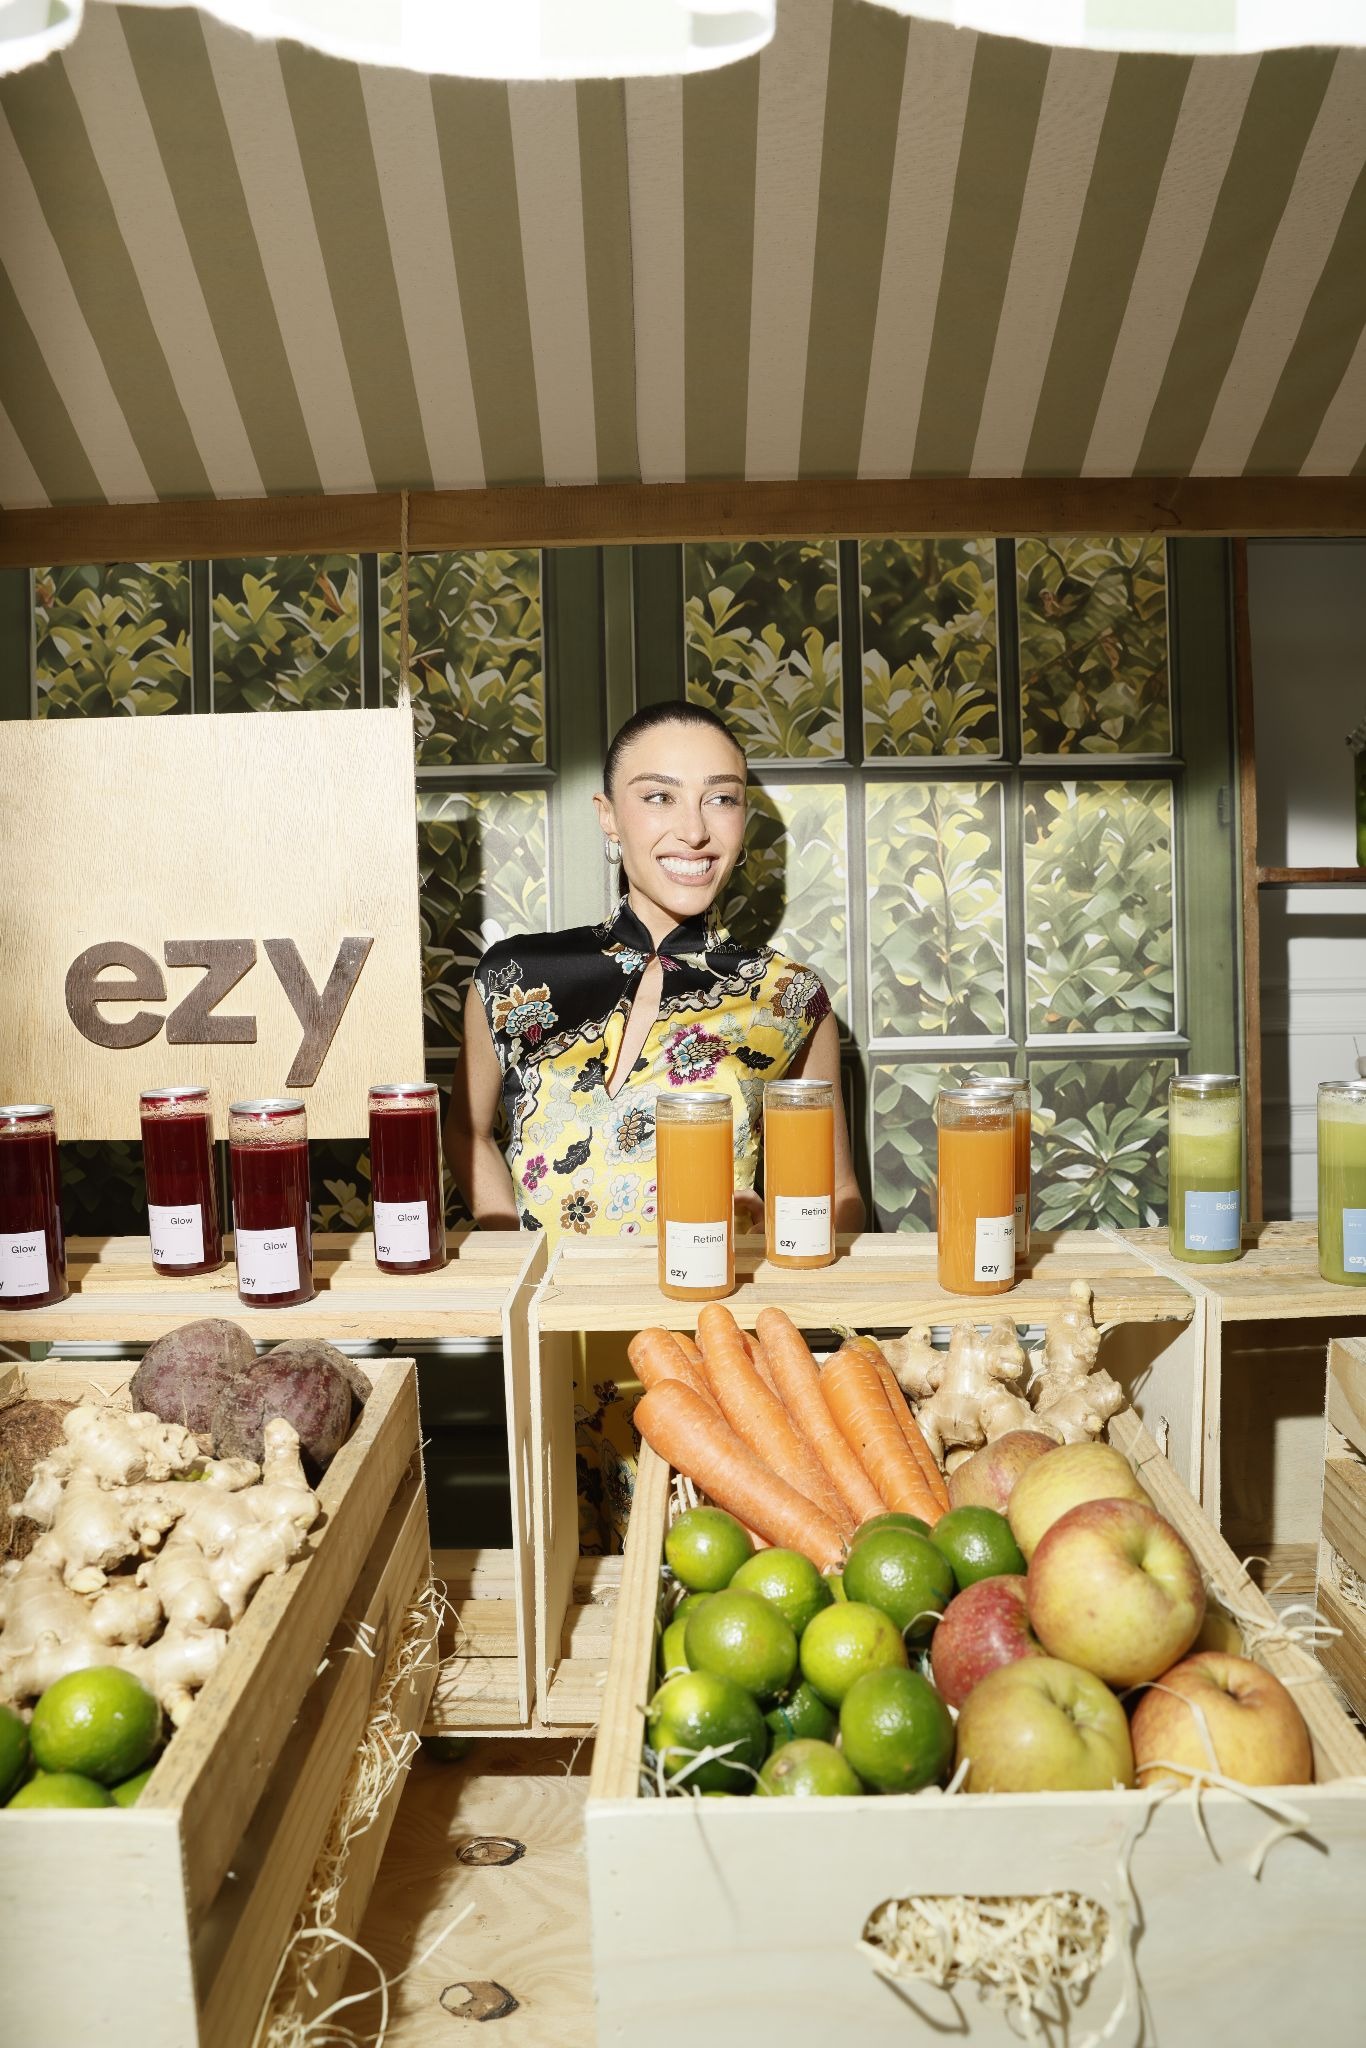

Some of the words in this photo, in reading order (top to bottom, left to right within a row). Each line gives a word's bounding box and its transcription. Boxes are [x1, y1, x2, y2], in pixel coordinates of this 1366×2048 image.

[65, 937, 374, 1087] ezy
[1216, 1202, 1237, 1211] Boost
[170, 1217, 193, 1225] Glow
[397, 1214, 420, 1222] Glow
[693, 1233, 724, 1244] Retinol
[1189, 1234, 1208, 1245] ezy
[263, 1242, 288, 1250] Glow
[779, 1240, 797, 1249] ezy
[11, 1245, 37, 1254] Glow
[378, 1245, 391, 1255] ezy
[670, 1268, 688, 1280] ezy
[981, 1265, 1000, 1274] ezy
[241, 1277, 256, 1287] ezy
